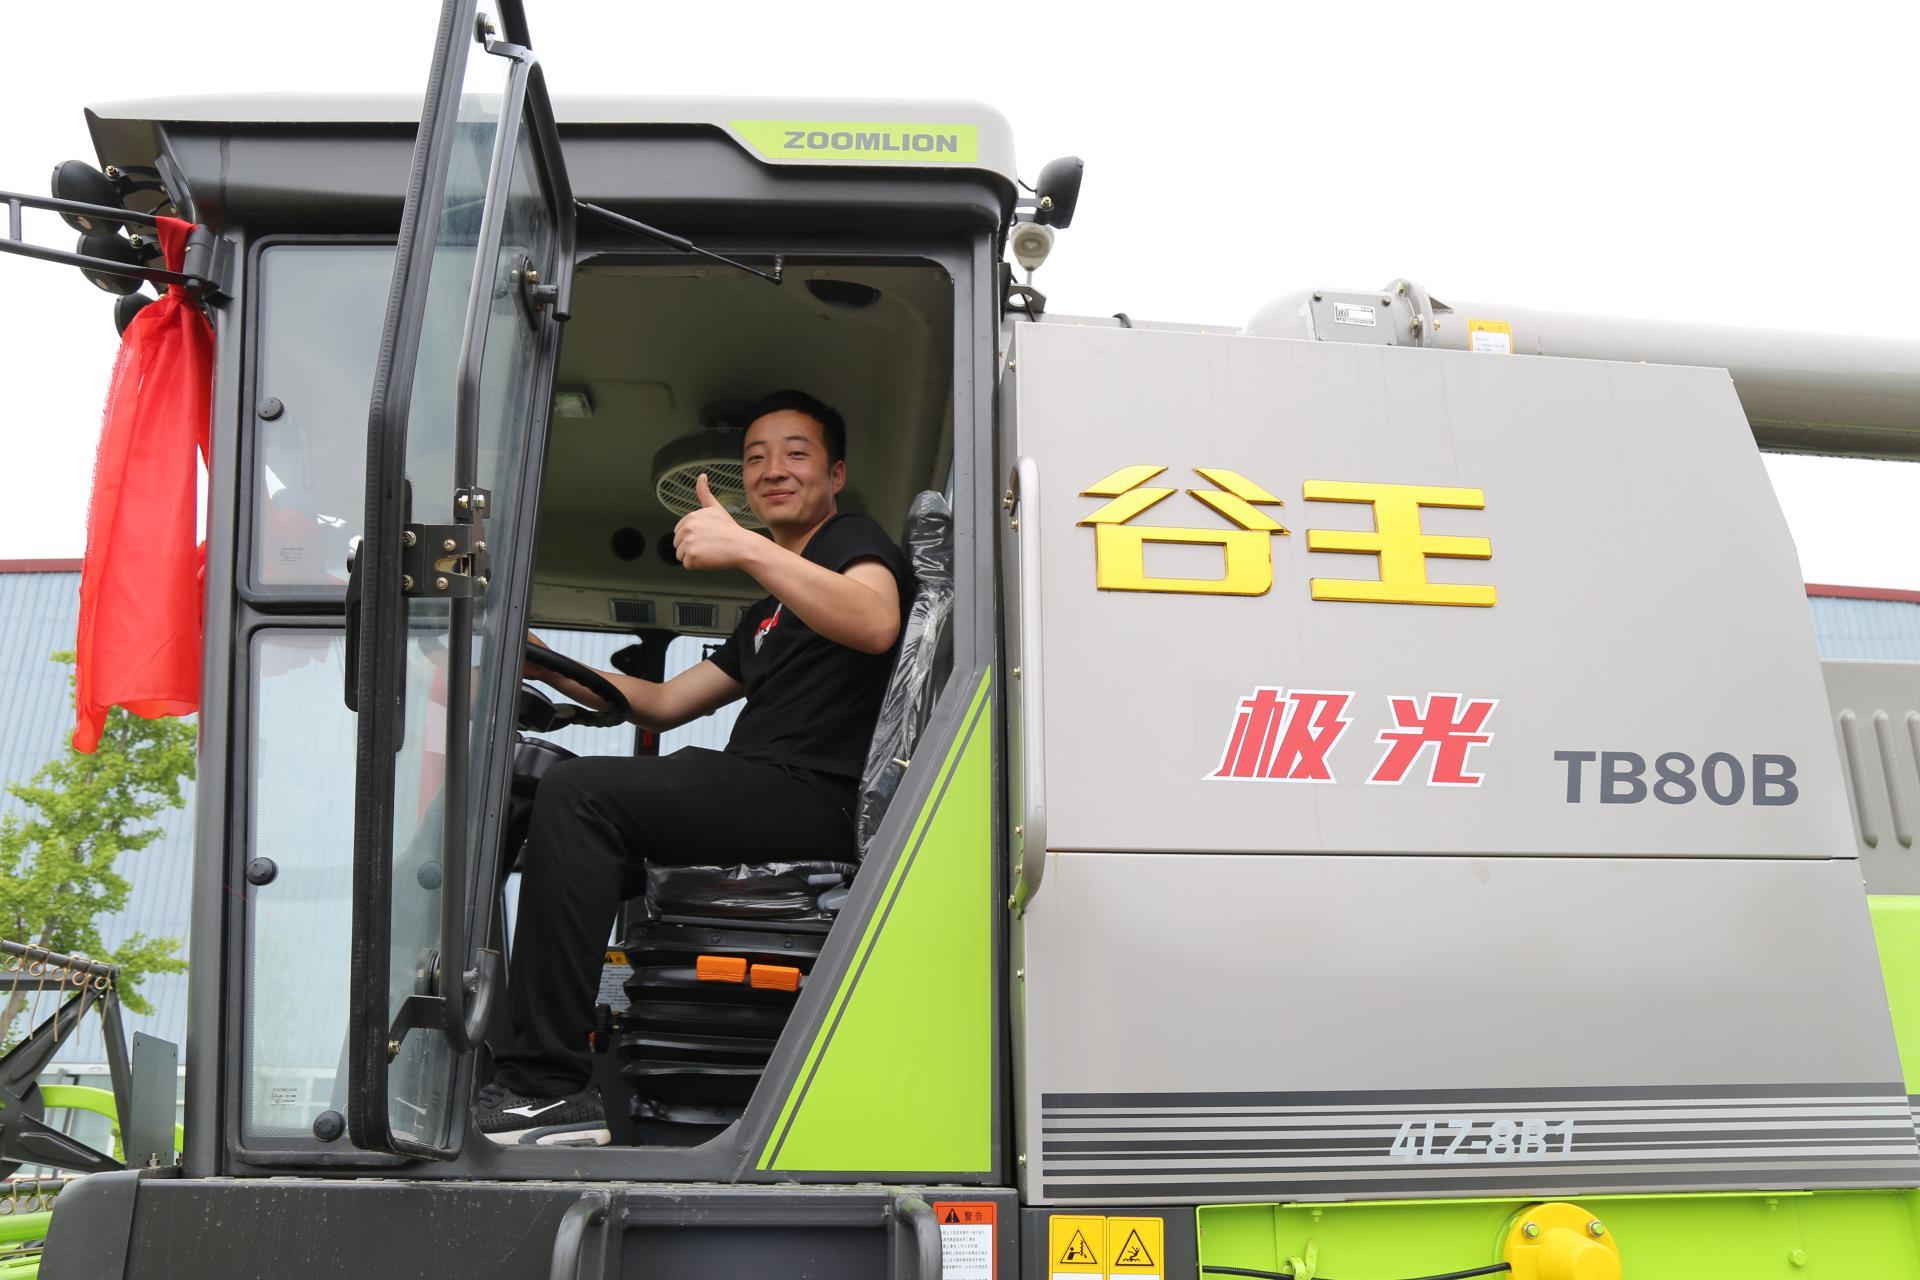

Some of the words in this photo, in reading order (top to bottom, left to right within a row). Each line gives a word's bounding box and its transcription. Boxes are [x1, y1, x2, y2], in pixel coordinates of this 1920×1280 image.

[783, 131, 958, 153] ZOOMLION
[1076, 465, 1498, 607] 谷王
[1203, 686, 1499, 787] 极光
[1554, 750, 1799, 806] TB80B
[1389, 1119, 1575, 1162] 4LZ-8B1
